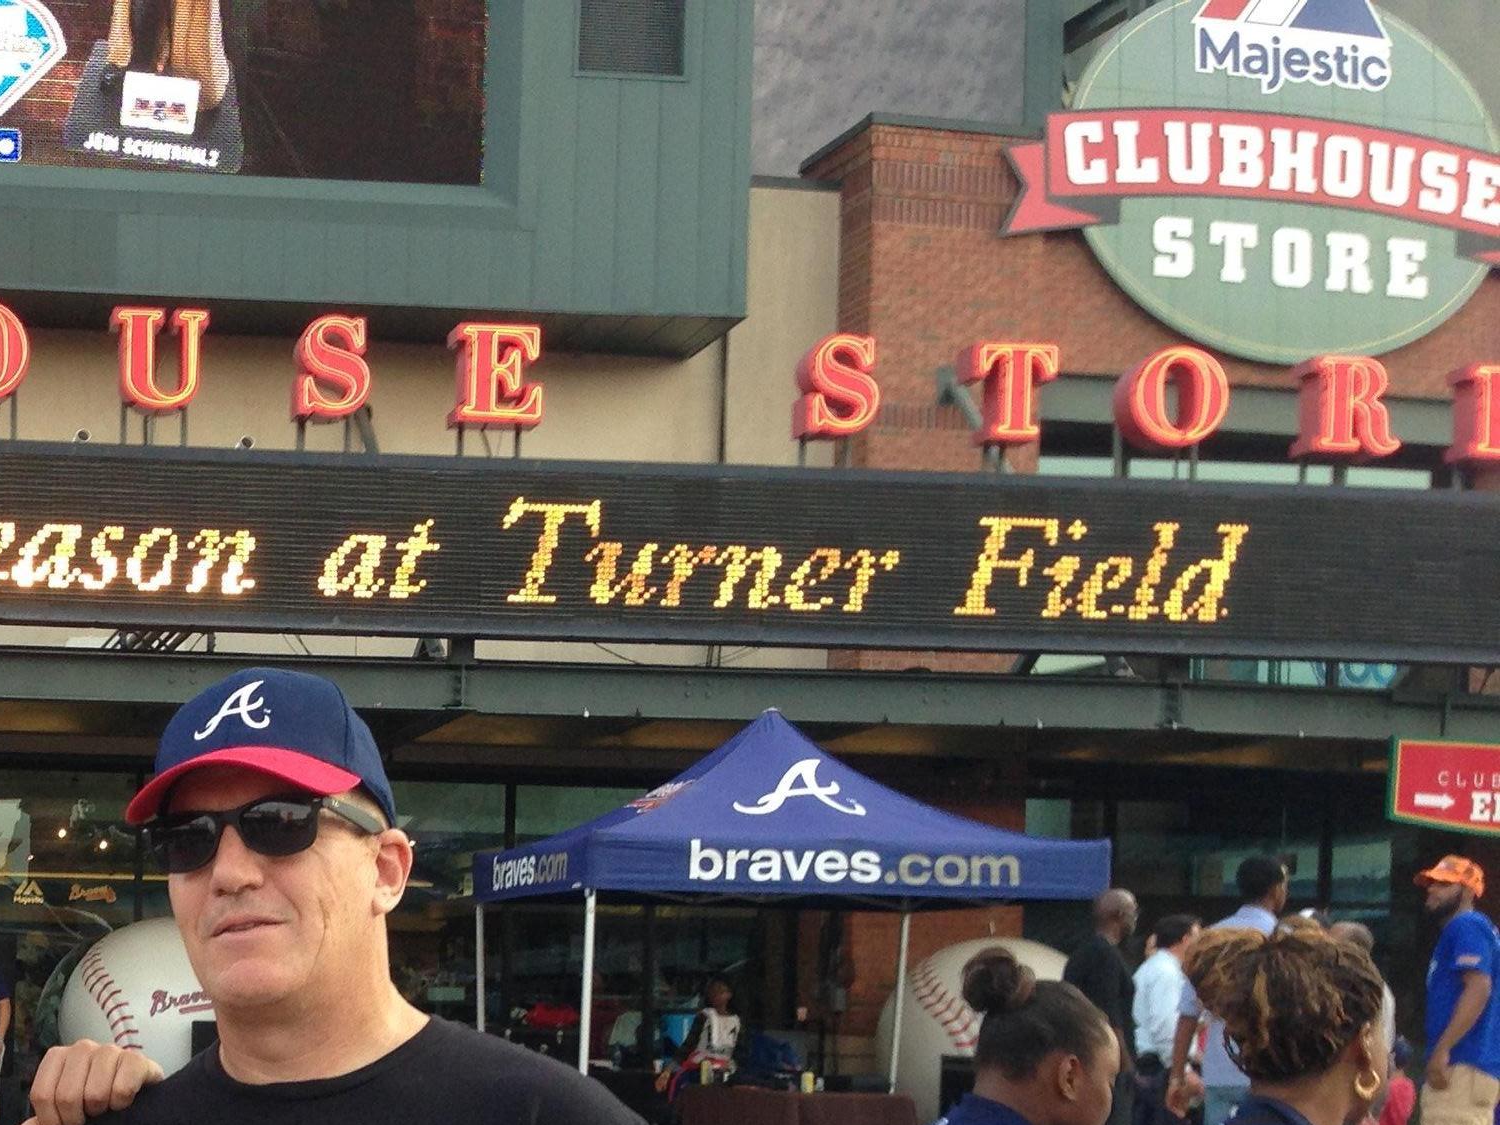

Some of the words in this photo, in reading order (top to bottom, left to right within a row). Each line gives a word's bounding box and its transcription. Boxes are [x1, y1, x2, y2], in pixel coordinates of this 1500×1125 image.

[1200, 27, 1388, 90] Majestic
[1064, 120, 1500, 226] CLUBHOUSE
[1153, 215, 1429, 299] STORE
[317, 517, 440, 600] at
[503, 497, 900, 612] Turner
[953, 516, 1249, 624] Field
[492, 851, 569, 892] braves.com
[689, 839, 1021, 888] braves.com
